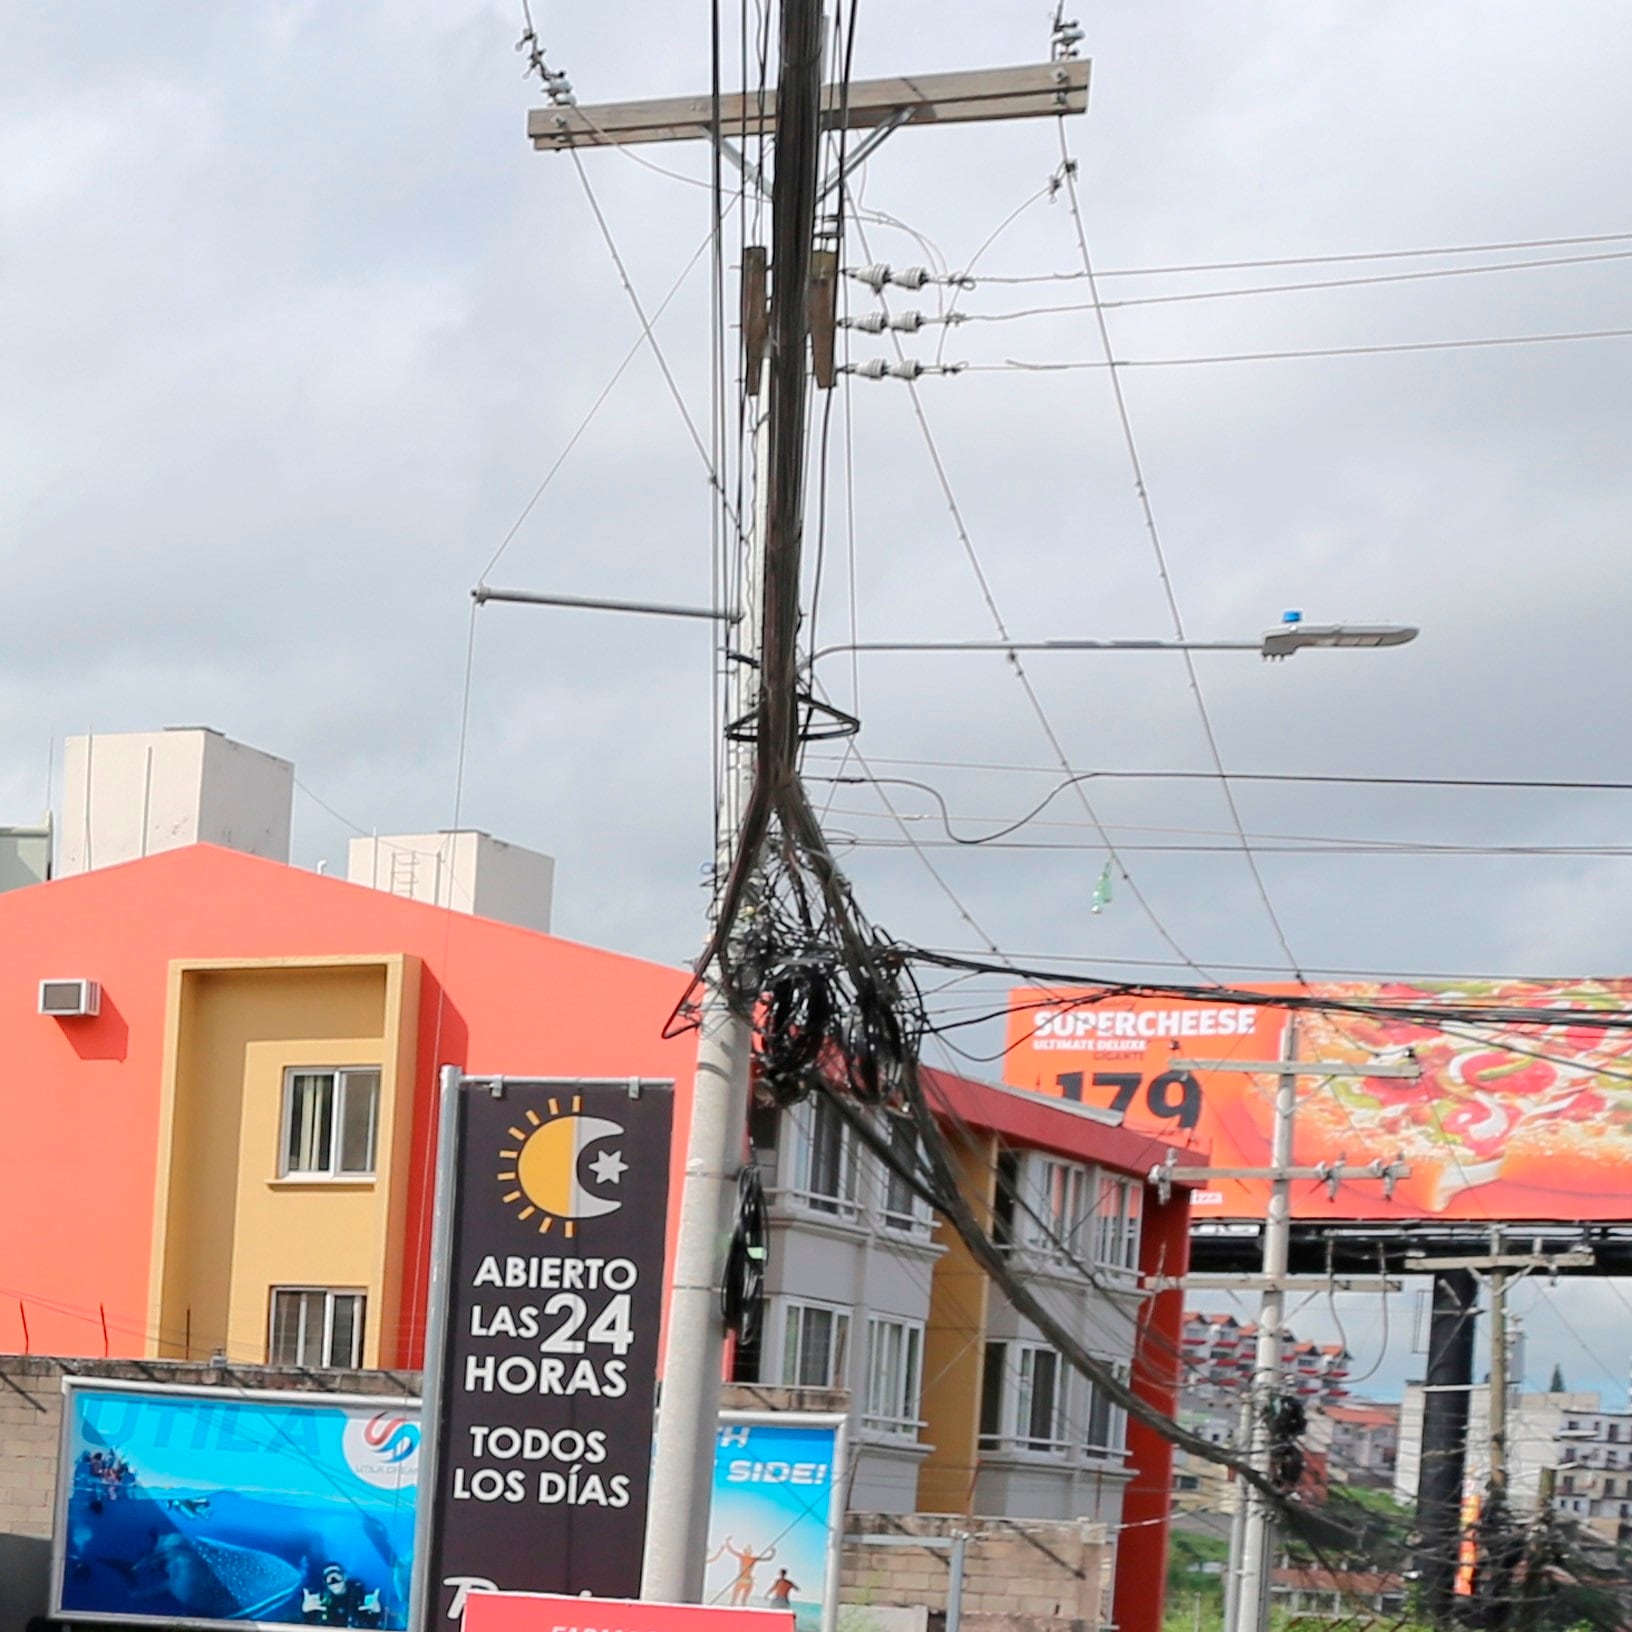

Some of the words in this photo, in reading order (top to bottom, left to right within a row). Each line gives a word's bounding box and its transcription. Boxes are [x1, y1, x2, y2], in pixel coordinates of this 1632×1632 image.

[1033, 1008, 1257, 1038] SUPERCHEESE
[1032, 1039, 1094, 1051] ULTIMATE
[1095, 1040, 1146, 1051] DELUXE
[472, 1255, 638, 1292] ABIERTO
[470, 1303, 539, 1340] LAS
[539, 1291, 635, 1356] 24
[464, 1355, 628, 1399] HORAS
[81, 1398, 322, 1456] UTILA
[470, 1425, 608, 1464] TODOS
[452, 1467, 527, 1502] LOS
[538, 1466, 631, 1509] DÍAS
[726, 1459, 828, 1485] SIDE!
